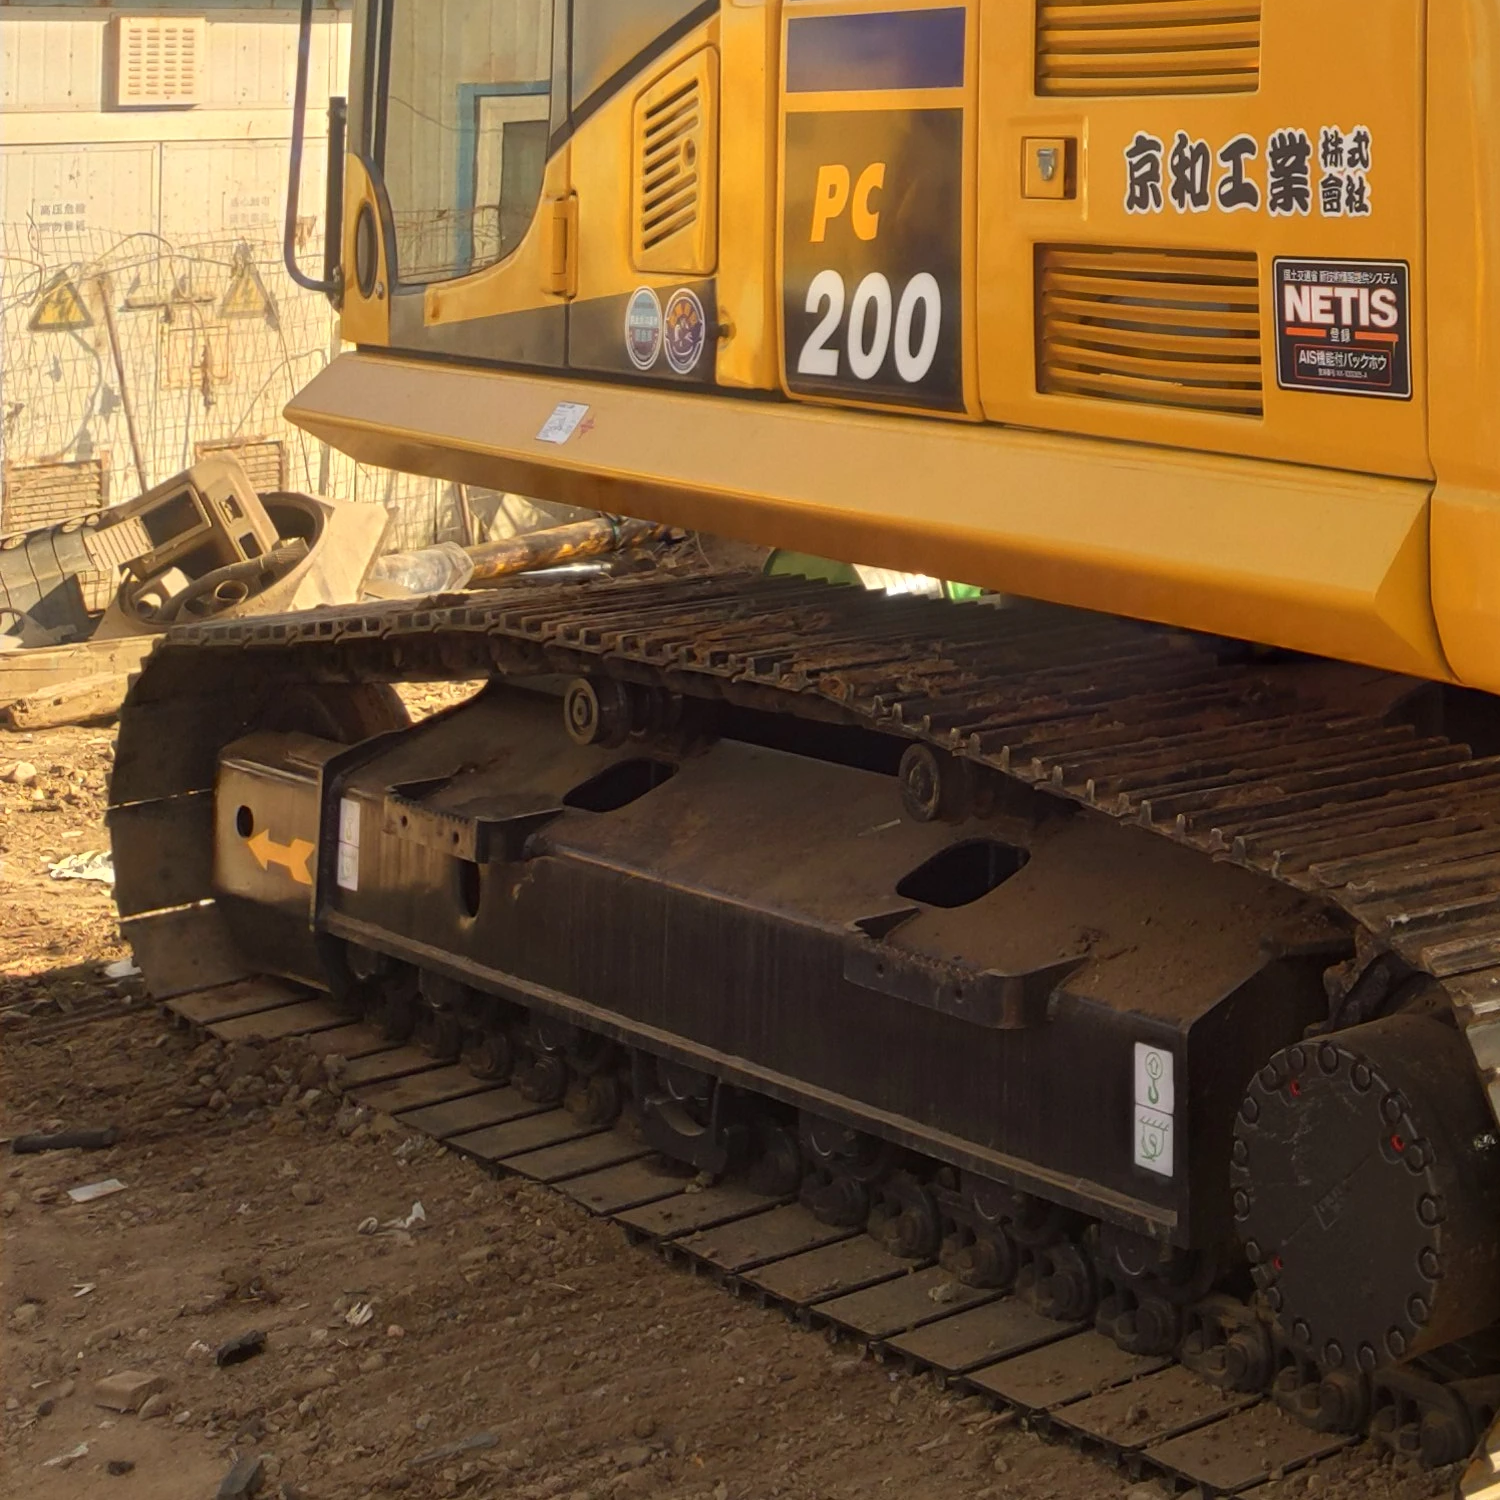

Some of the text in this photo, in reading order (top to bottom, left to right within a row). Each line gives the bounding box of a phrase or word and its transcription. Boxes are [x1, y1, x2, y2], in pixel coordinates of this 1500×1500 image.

[809, 162, 886, 242] PC
[1124, 131, 1313, 214] 京和工業
[798, 269, 942, 383] 200
[1284, 285, 1399, 328] NETIS
